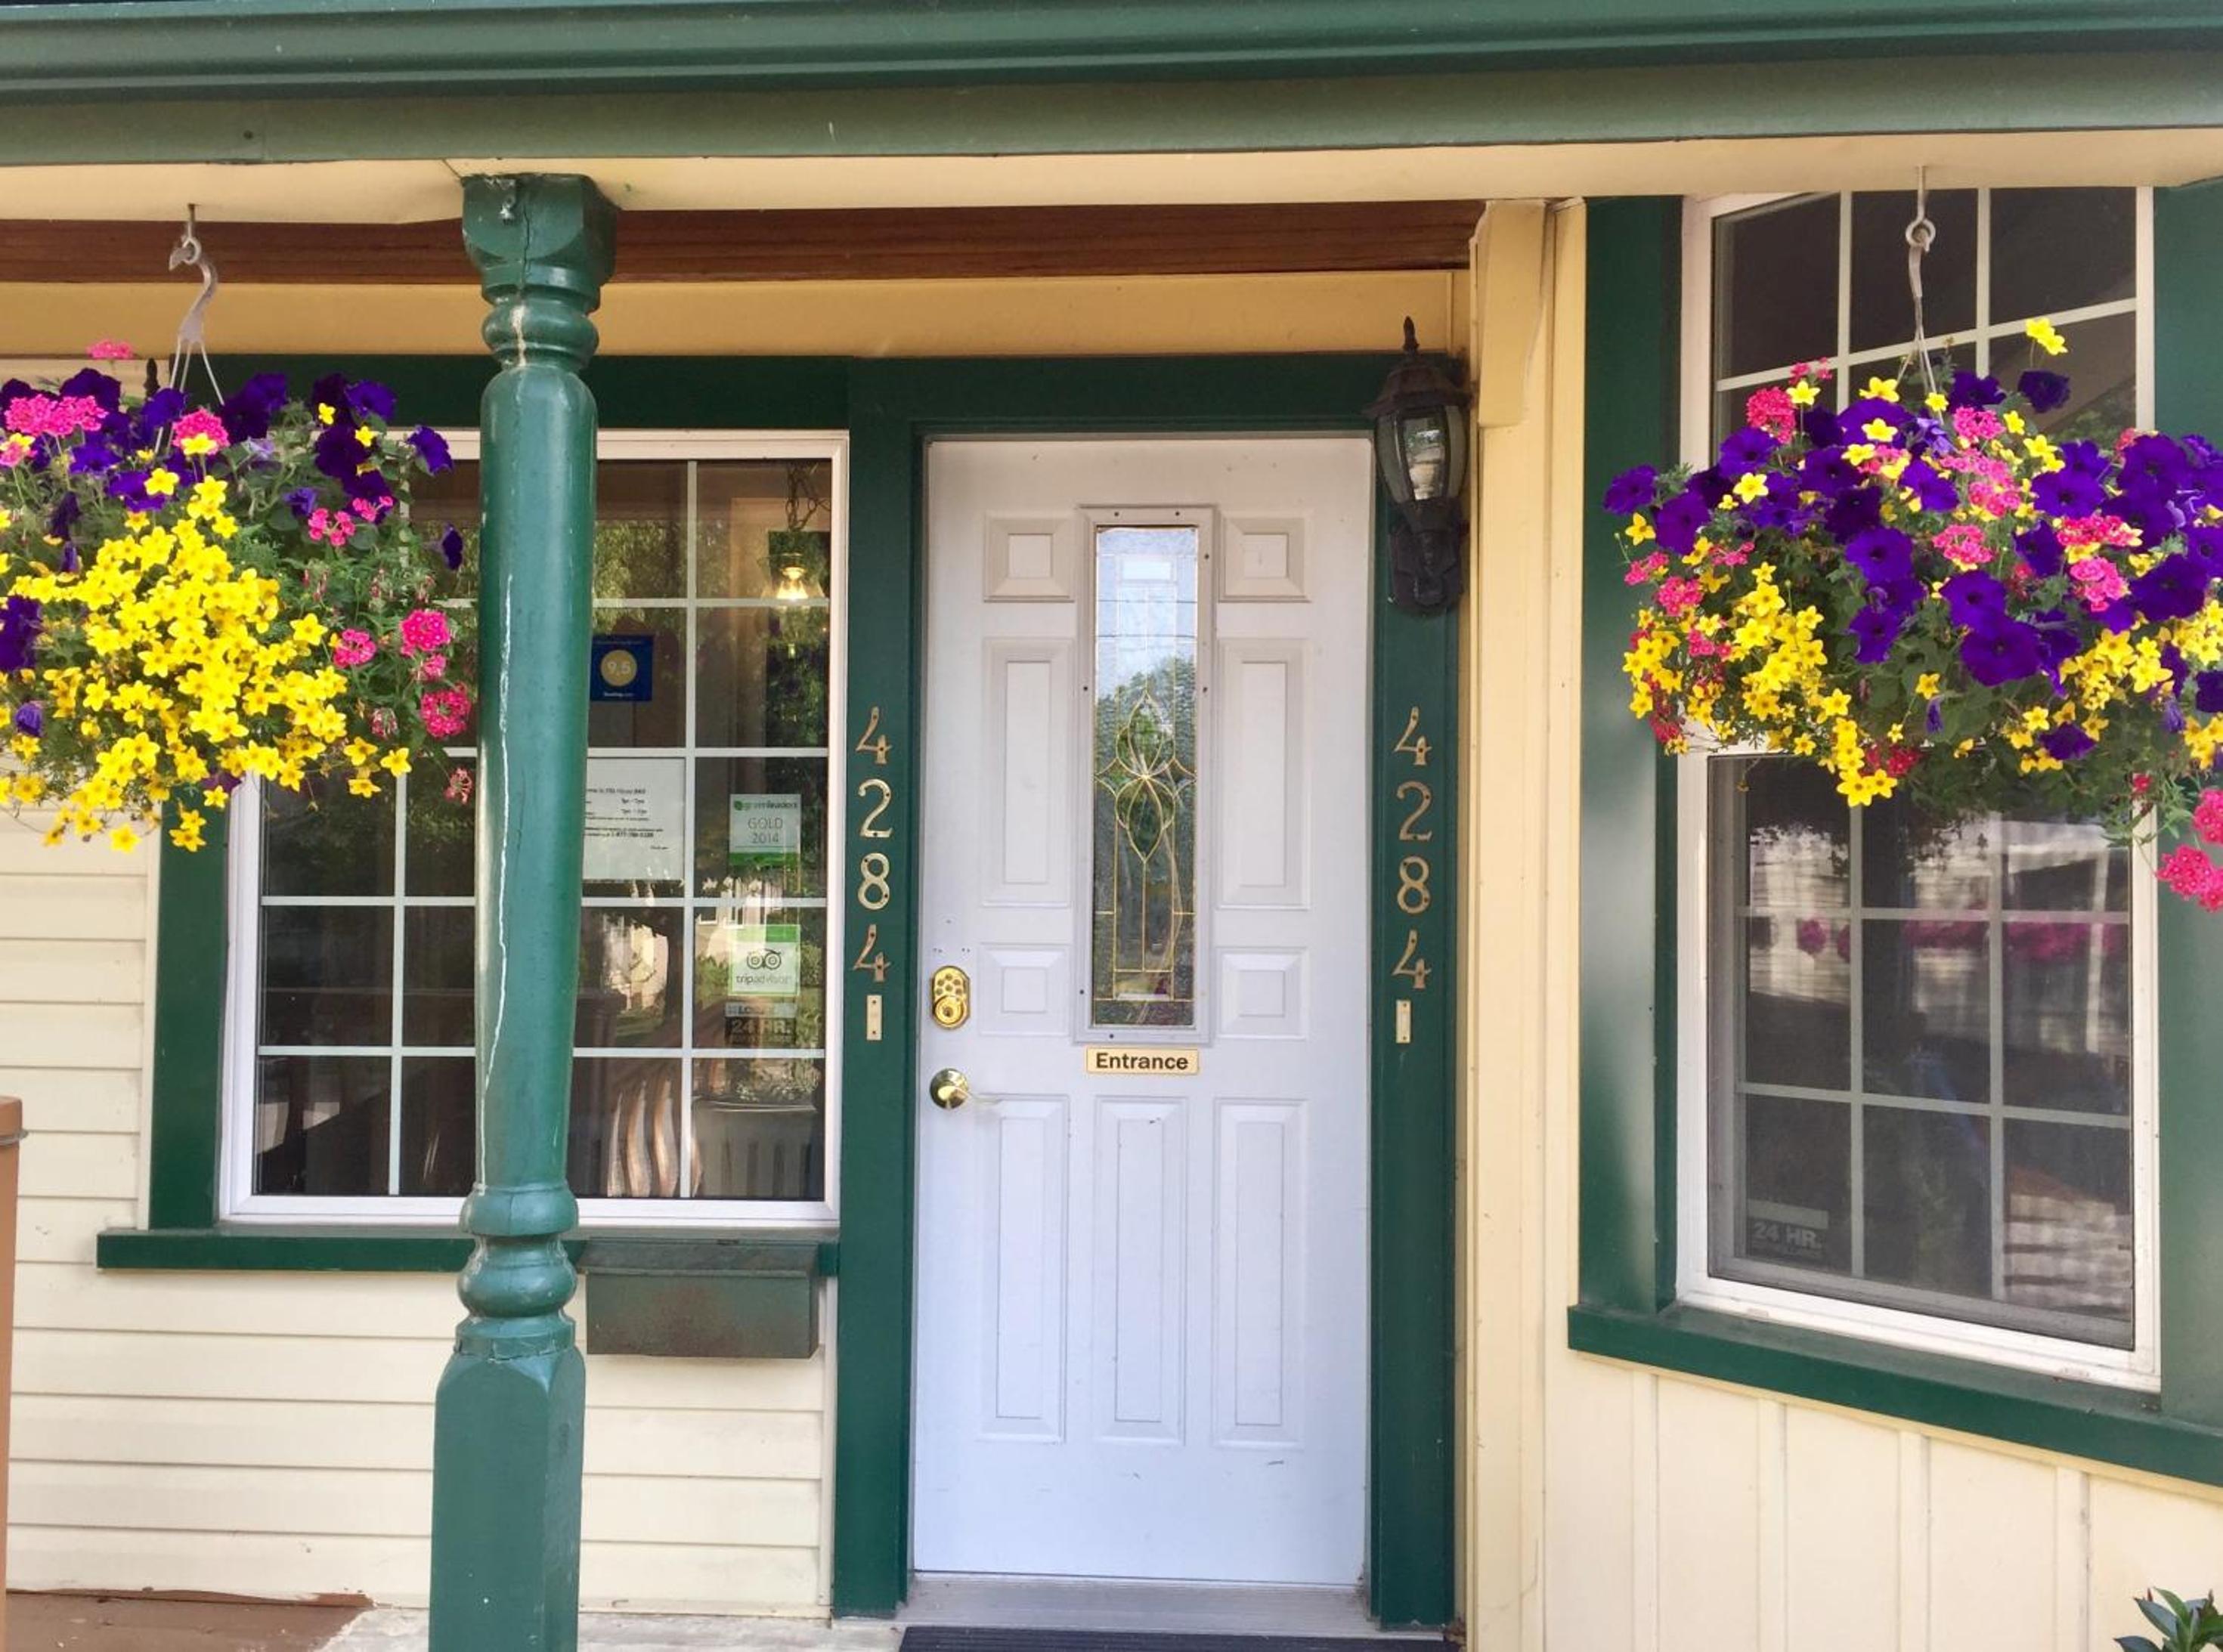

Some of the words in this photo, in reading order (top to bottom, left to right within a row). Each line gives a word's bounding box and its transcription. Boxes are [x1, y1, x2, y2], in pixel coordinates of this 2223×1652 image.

[747, 817, 783, 830] GOLD
[751, 832, 779, 844] 2014
[1096, 1052, 1189, 1070] Entrance
[1753, 1221, 1779, 1242] 24
